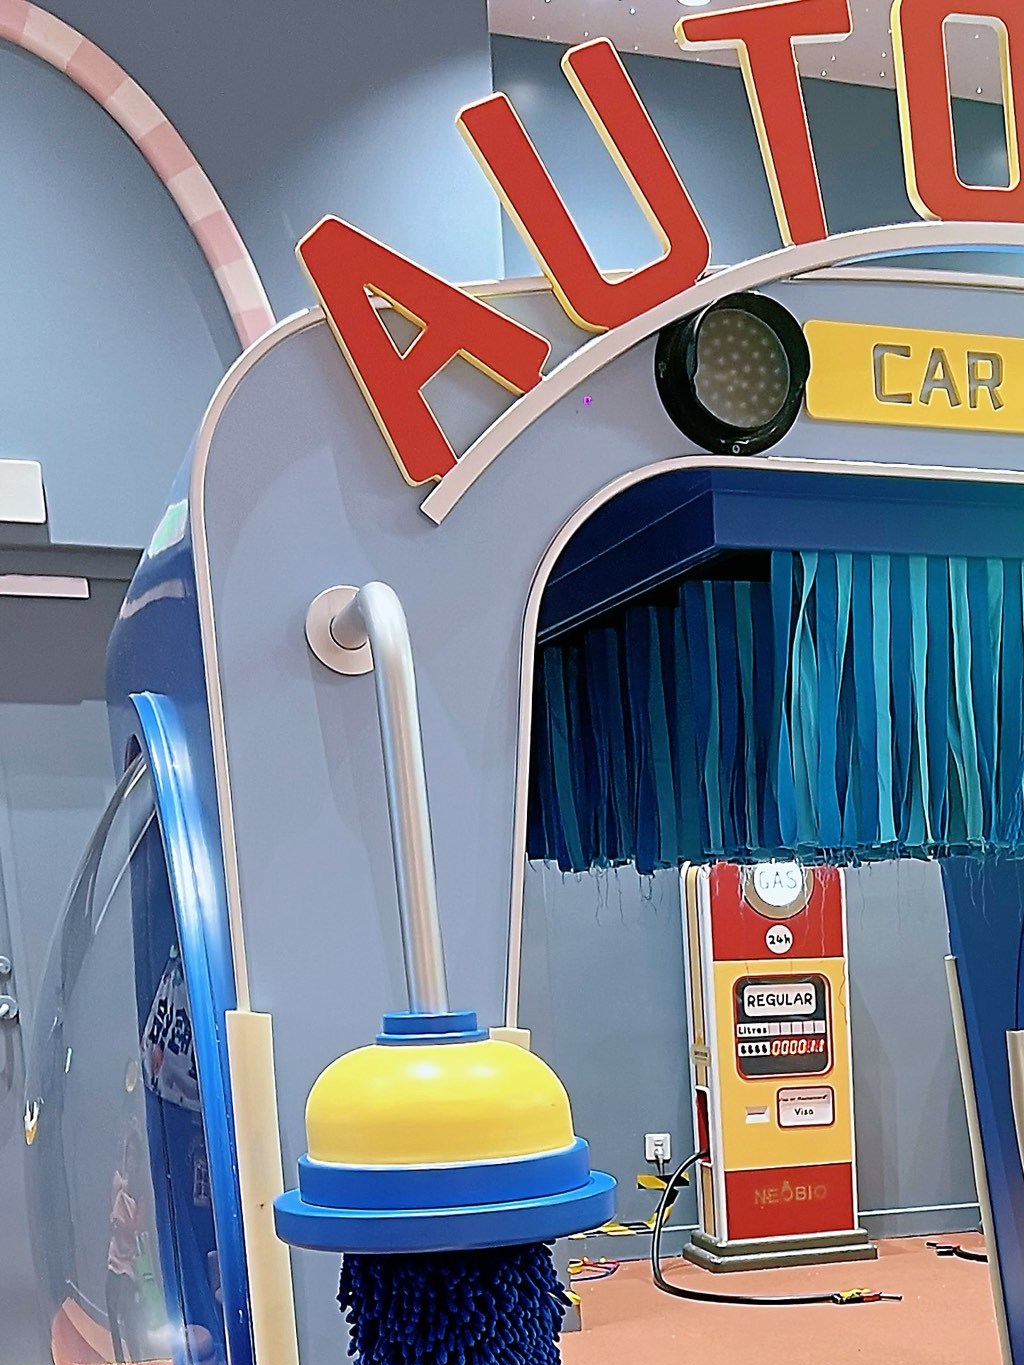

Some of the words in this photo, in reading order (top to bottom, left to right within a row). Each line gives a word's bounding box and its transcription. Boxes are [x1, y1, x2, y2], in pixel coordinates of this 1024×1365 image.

[872, 343, 1005, 411] CAR
[759, 870, 797, 890] GAS
[768, 933, 791, 945] 24h
[747, 992, 813, 1008] REGULAR
[738, 1026, 767, 1035] Litres
[794, 1107, 814, 1116] Visa
[754, 1181, 827, 1205] NEOBIO
